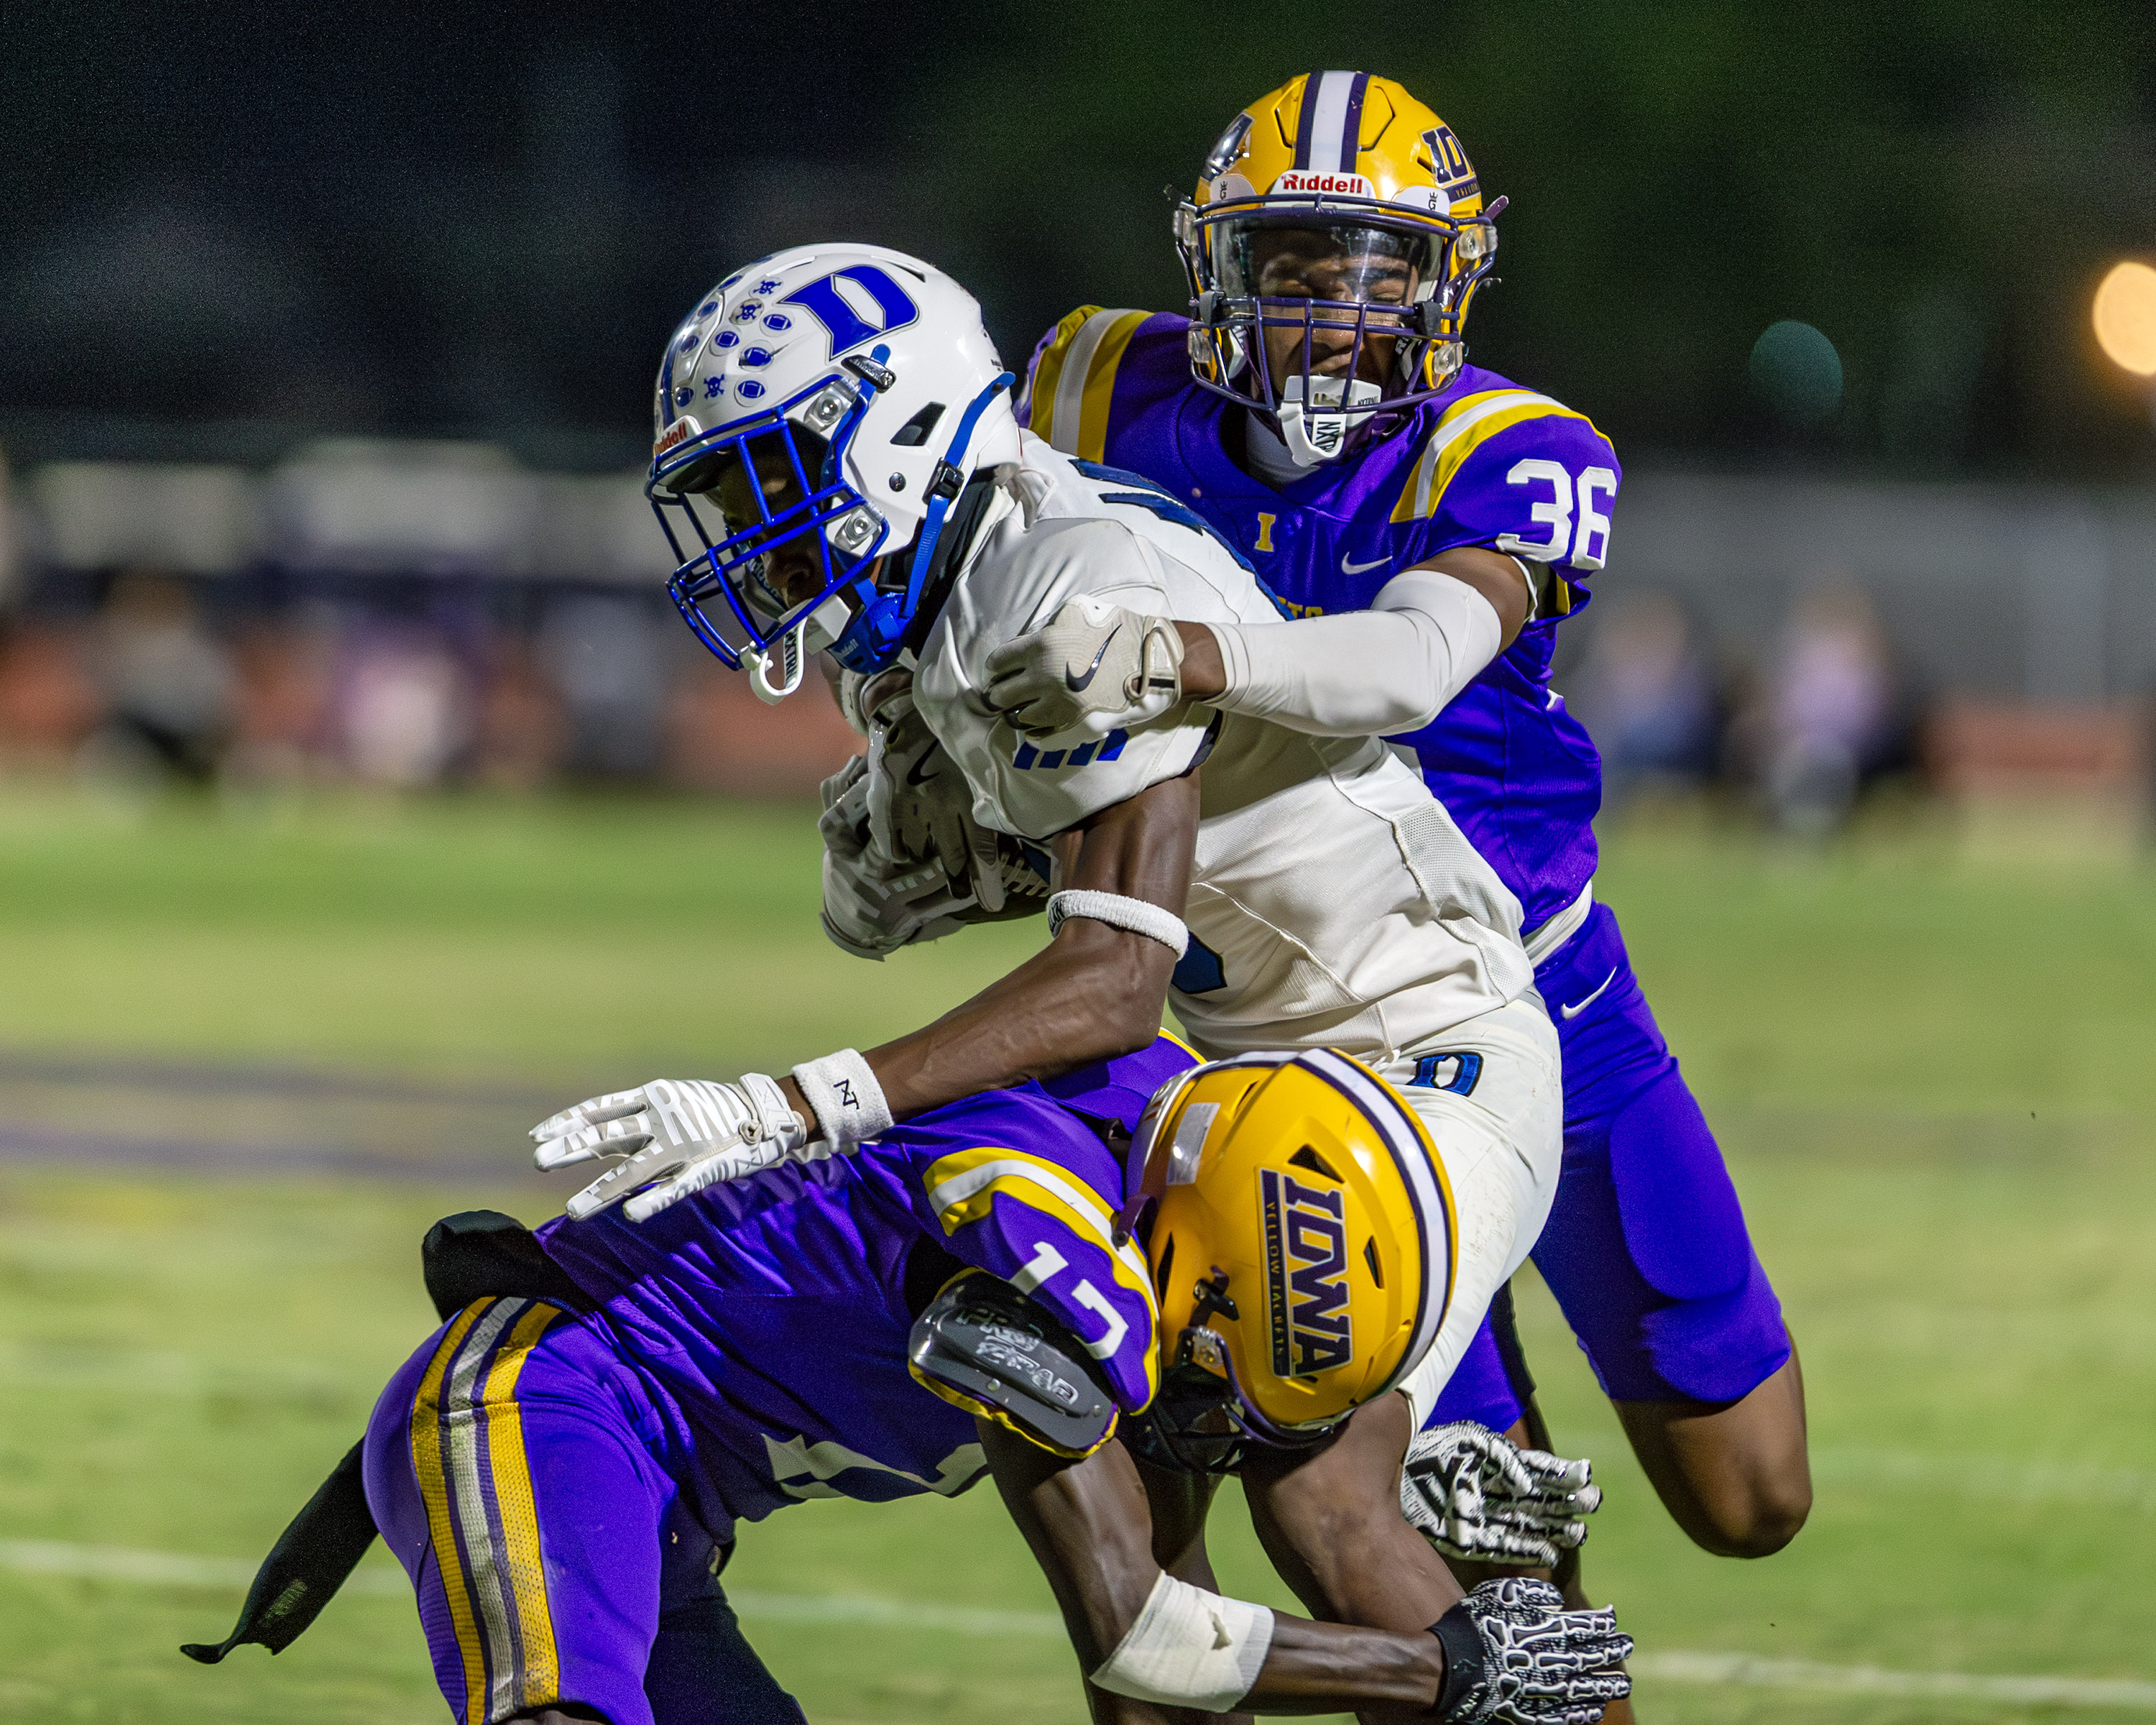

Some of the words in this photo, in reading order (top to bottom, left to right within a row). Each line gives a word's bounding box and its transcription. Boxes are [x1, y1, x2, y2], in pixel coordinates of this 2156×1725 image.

[1281, 173, 1363, 193] Riddell
[1422, 126, 1475, 183] IO
[775, 264, 920, 362] D
[1254, 512, 1277, 553] I
[1494, 458, 1618, 570] 36
[1406, 1051, 1484, 1097] D
[1266, 1201, 1281, 1274] YELLOW
[1010, 1241, 1129, 1360] 17
[1283, 1174, 1353, 1377] IOWA
